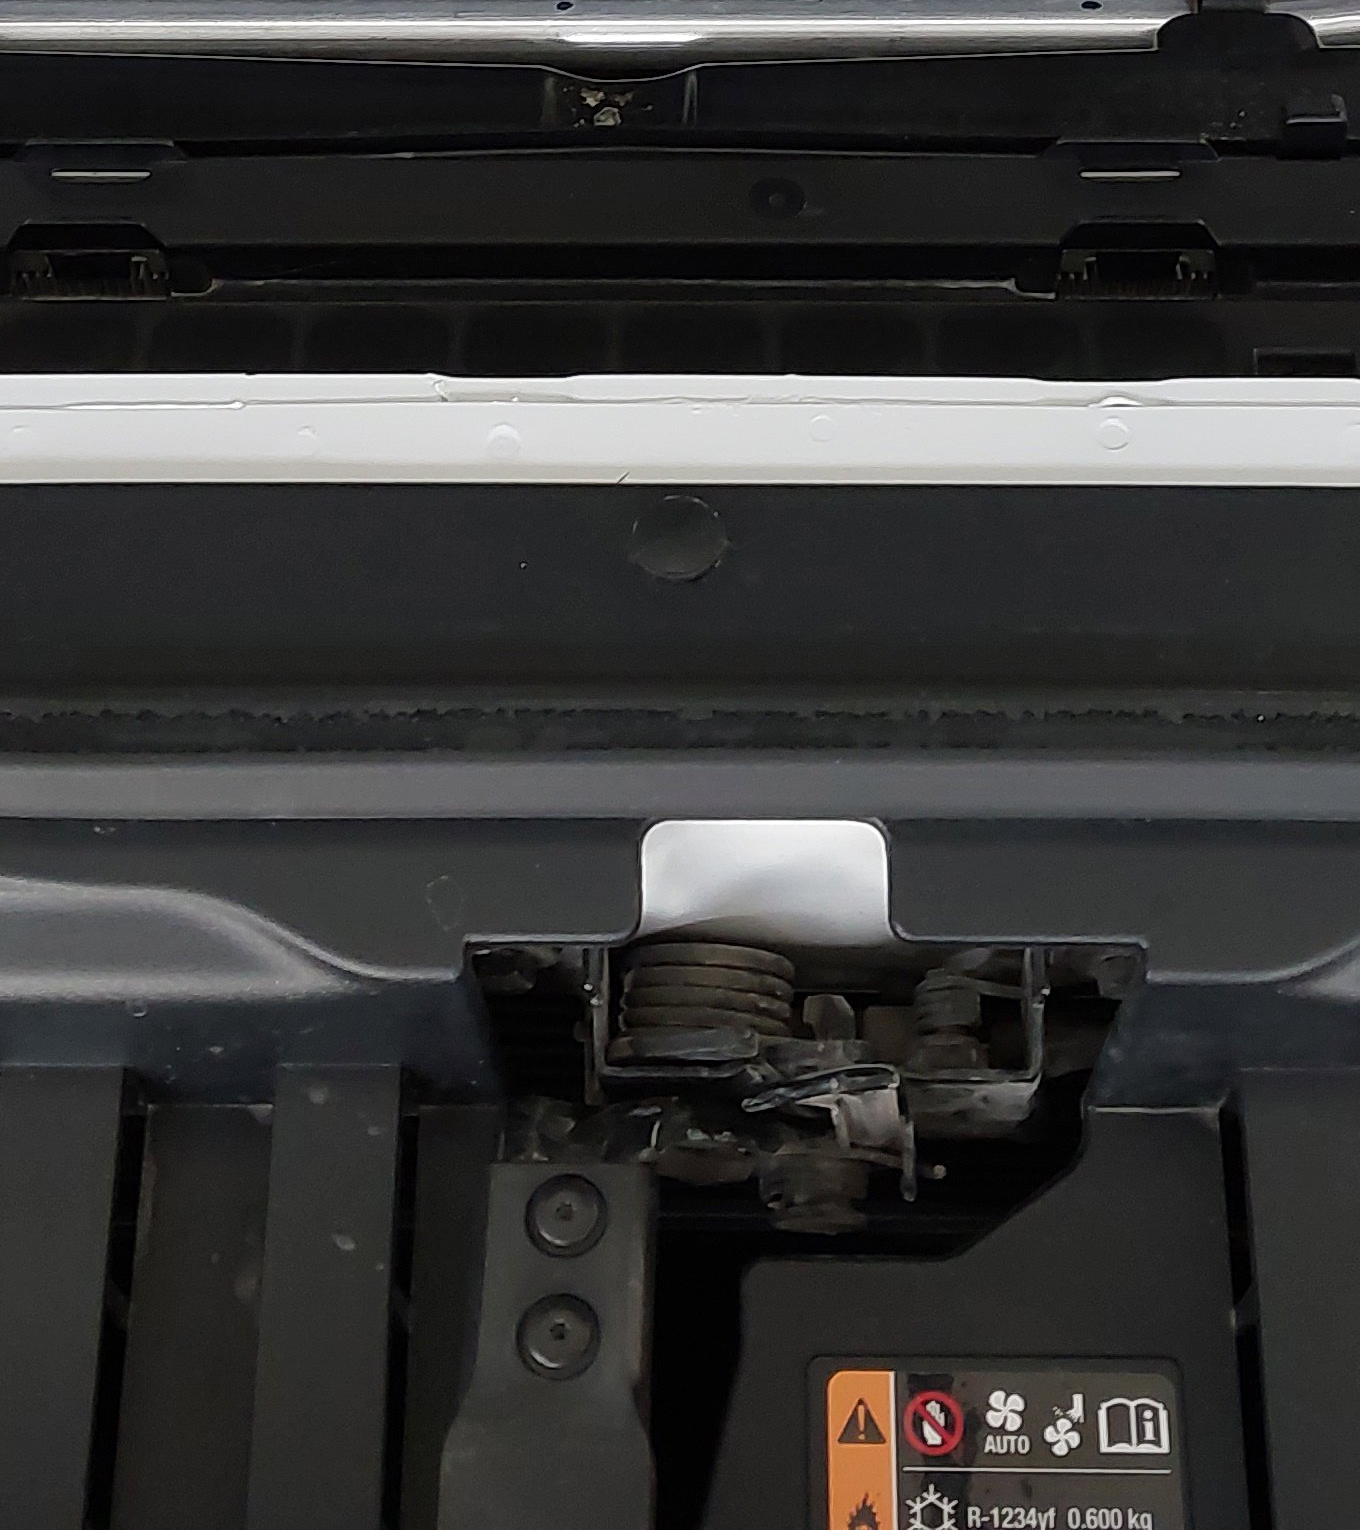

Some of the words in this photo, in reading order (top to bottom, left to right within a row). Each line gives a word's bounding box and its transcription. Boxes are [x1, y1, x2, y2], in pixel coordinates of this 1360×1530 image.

[983, 1434, 1030, 1455] AUTO
[967, 1506, 1056, 1530] R-1234yf
[1067, 1507, 1123, 1530] 0.600
[1127, 1507, 1153, 1530] kg
